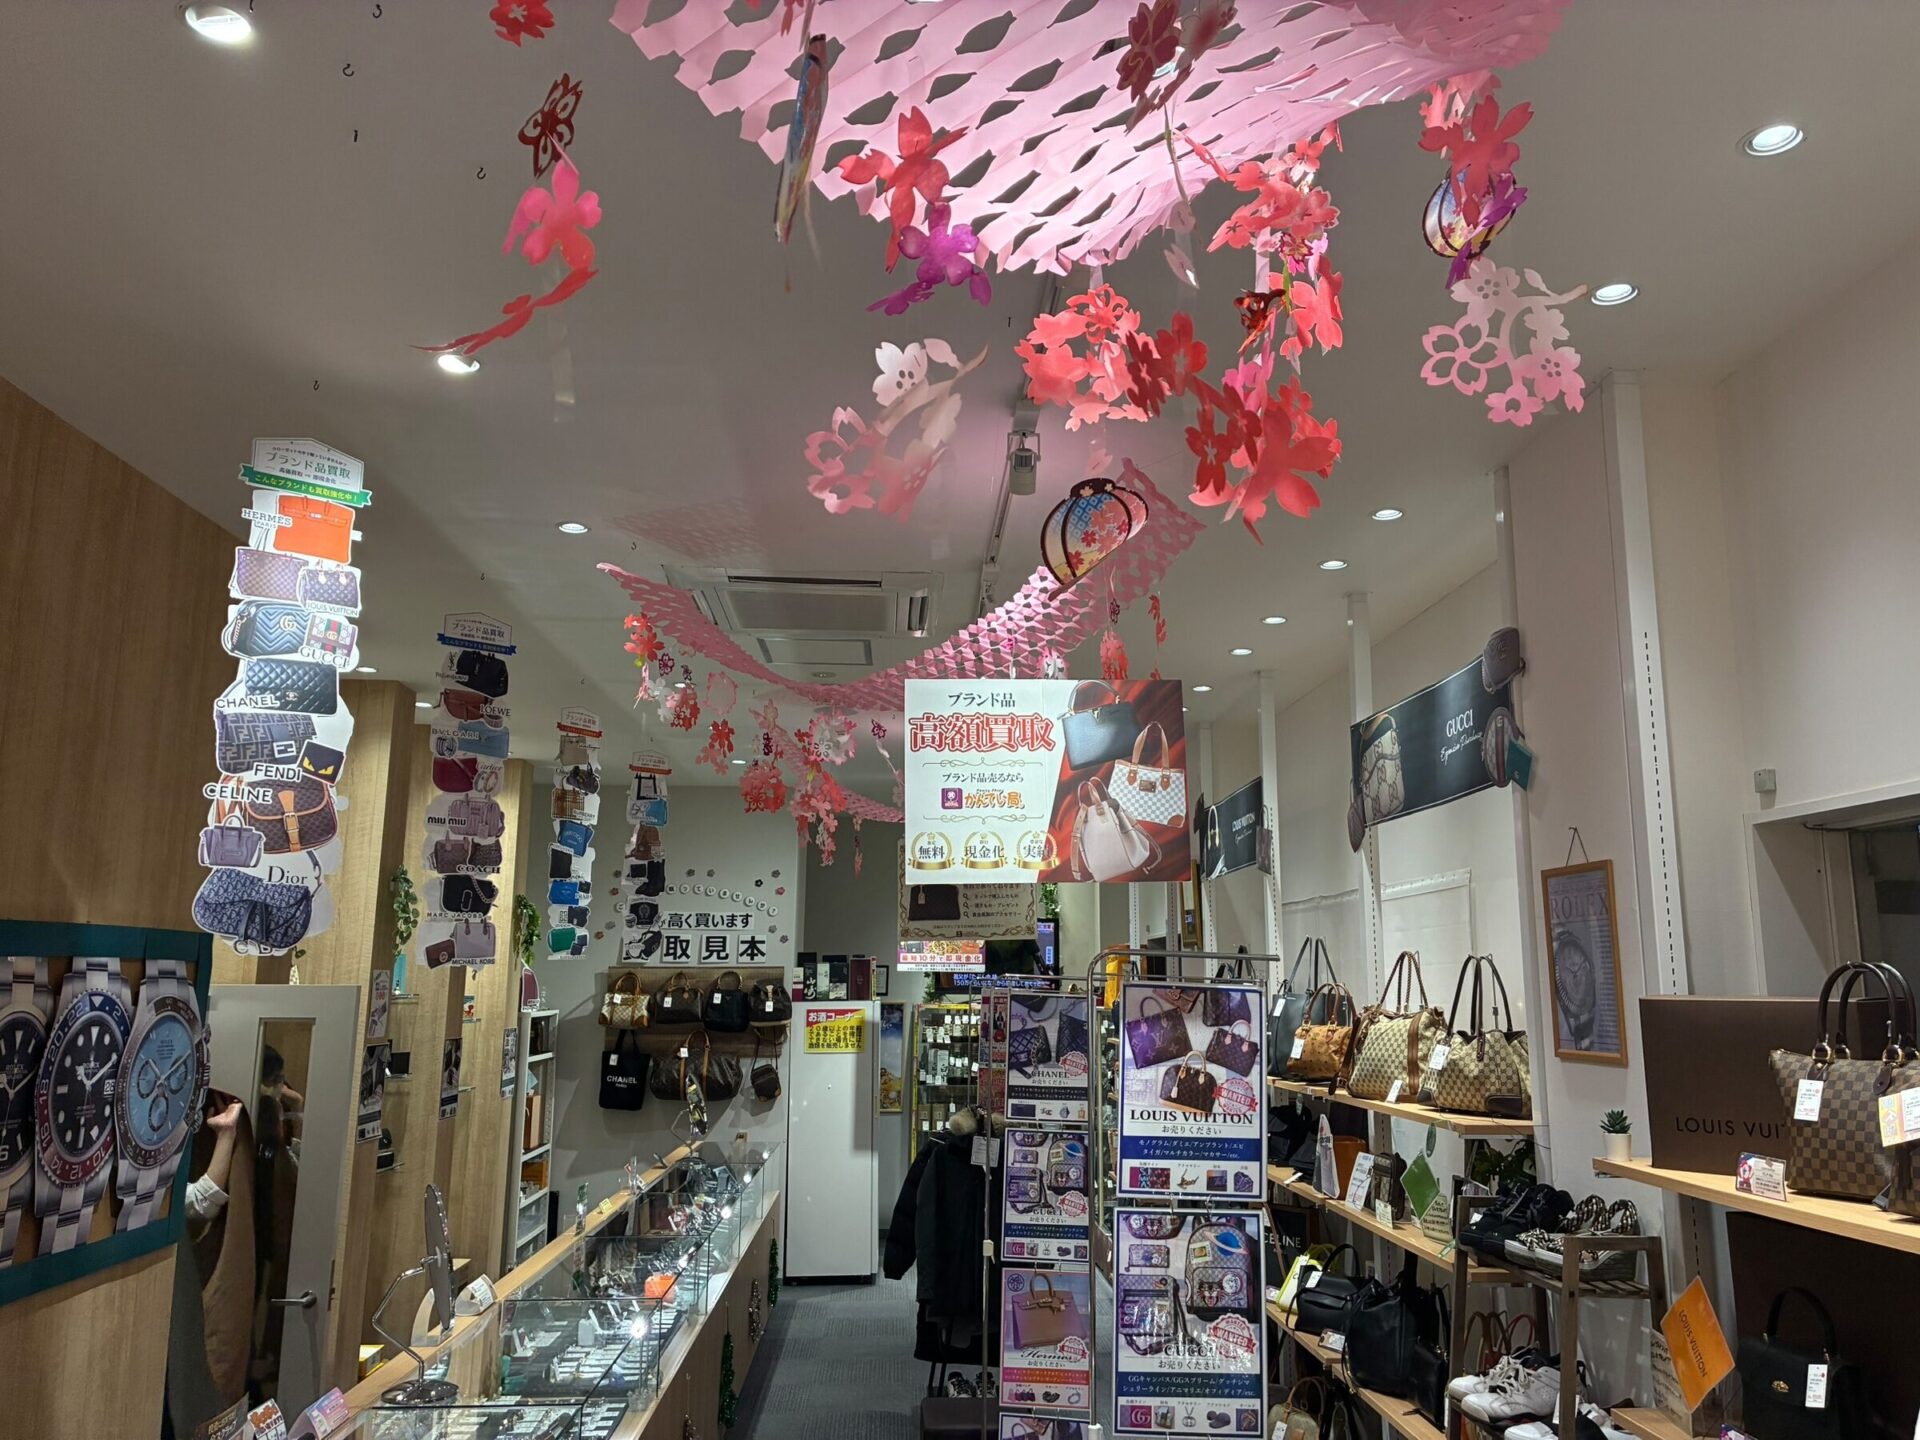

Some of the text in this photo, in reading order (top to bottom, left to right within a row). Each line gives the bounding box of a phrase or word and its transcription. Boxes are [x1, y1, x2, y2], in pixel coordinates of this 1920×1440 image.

[265, 451, 351, 480] ブランド品買取
[243, 509, 291, 526] HERMES
[307, 601, 359, 616] LOUIS VUITTON
[452, 622, 505, 639] ブランド品買取
[300, 646, 350, 668] GUCCI
[215, 695, 279, 709] CHANEL
[948, 692, 1016, 708] ブランド品
[480, 704, 511, 717] LOEWE
[1446, 708, 1473, 737] GUCCI
[432, 728, 482, 739] BVLGARI
[908, 712, 1056, 753] 高額買取
[254, 764, 302, 781] FENDI
[942, 772, 1024, 783] ブランド品売るなら
[204, 784, 272, 802] CELINE
[427, 816, 466, 826] miu miu
[918, 845, 945, 860] 無料
[964, 845, 1005, 859] 現金化
[266, 865, 308, 885] Dior
[456, 864, 501, 873] COACH
[1550, 892, 1609, 920] ROLEX
[663, 935, 767, 961] 取見本
[808, 1011, 864, 1023] お酒コーナー
[606, 1075, 638, 1084] CHANEL
[1031, 1070, 1070, 1079] CHANEL
[1221, 1087, 1251, 1106] WANTED
[1130, 1109, 1253, 1125] LOUIS VUITTON
[1161, 1125, 1222, 1135] お売りください
[1675, 1116, 1786, 1139] LOUIS VUI
[1033, 1208, 1063, 1216] GUCCI
[1264, 1232, 1301, 1248] CELINE
[1217, 1327, 1249, 1345] WANTED
[1679, 1309, 1708, 1378] LOUIS VUITTON
[1164, 1344, 1215, 1358] GUCCI
[1158, 1360, 1221, 1371] お売りください
